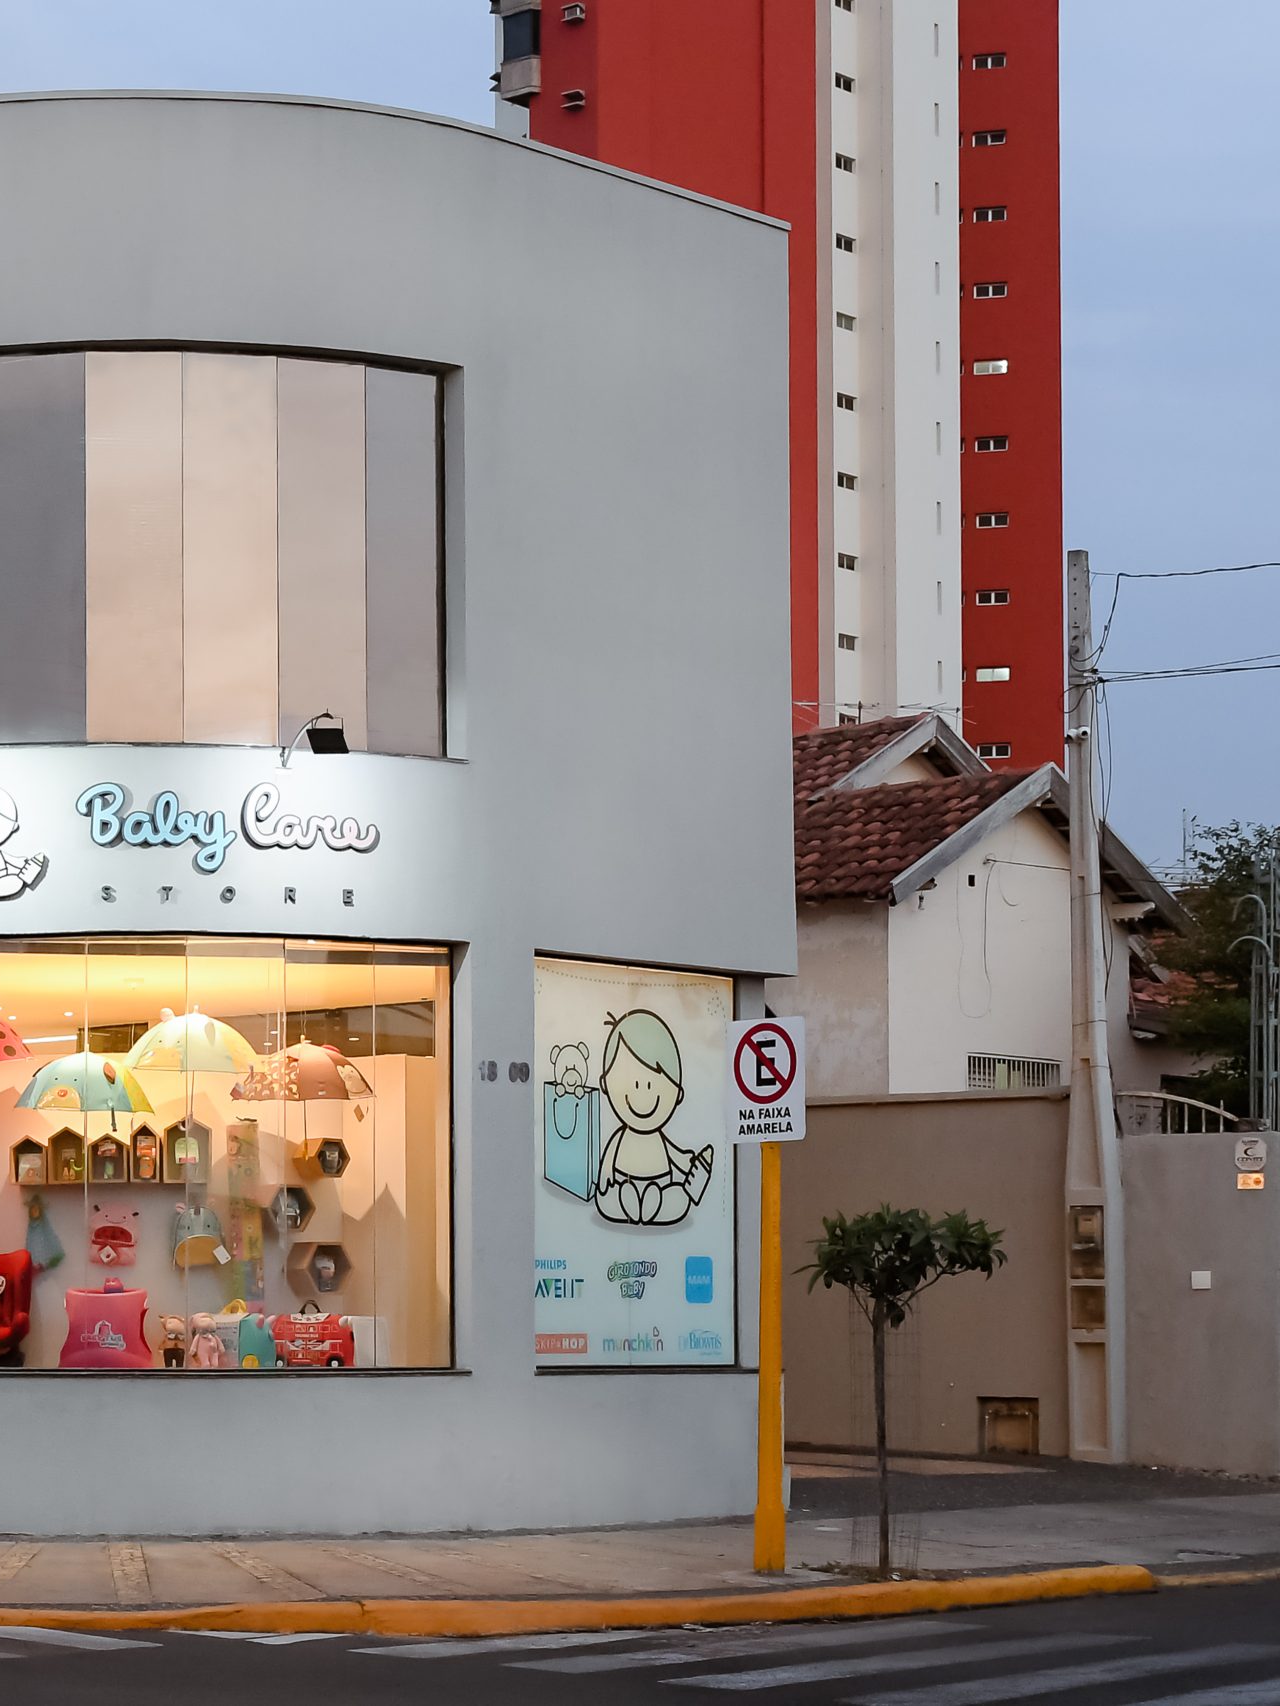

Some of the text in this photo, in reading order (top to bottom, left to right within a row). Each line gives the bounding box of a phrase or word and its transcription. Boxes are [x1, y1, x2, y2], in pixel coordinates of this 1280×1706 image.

[76, 781, 381, 874] Baby Care
[101, 884, 356, 907] STORE
[738, 1106, 792, 1121] NA FAIXA
[738, 1121, 794, 1136] AMARELA
[534, 1258, 568, 1271] PHILIPS
[562, 1336, 585, 1350] HOP
